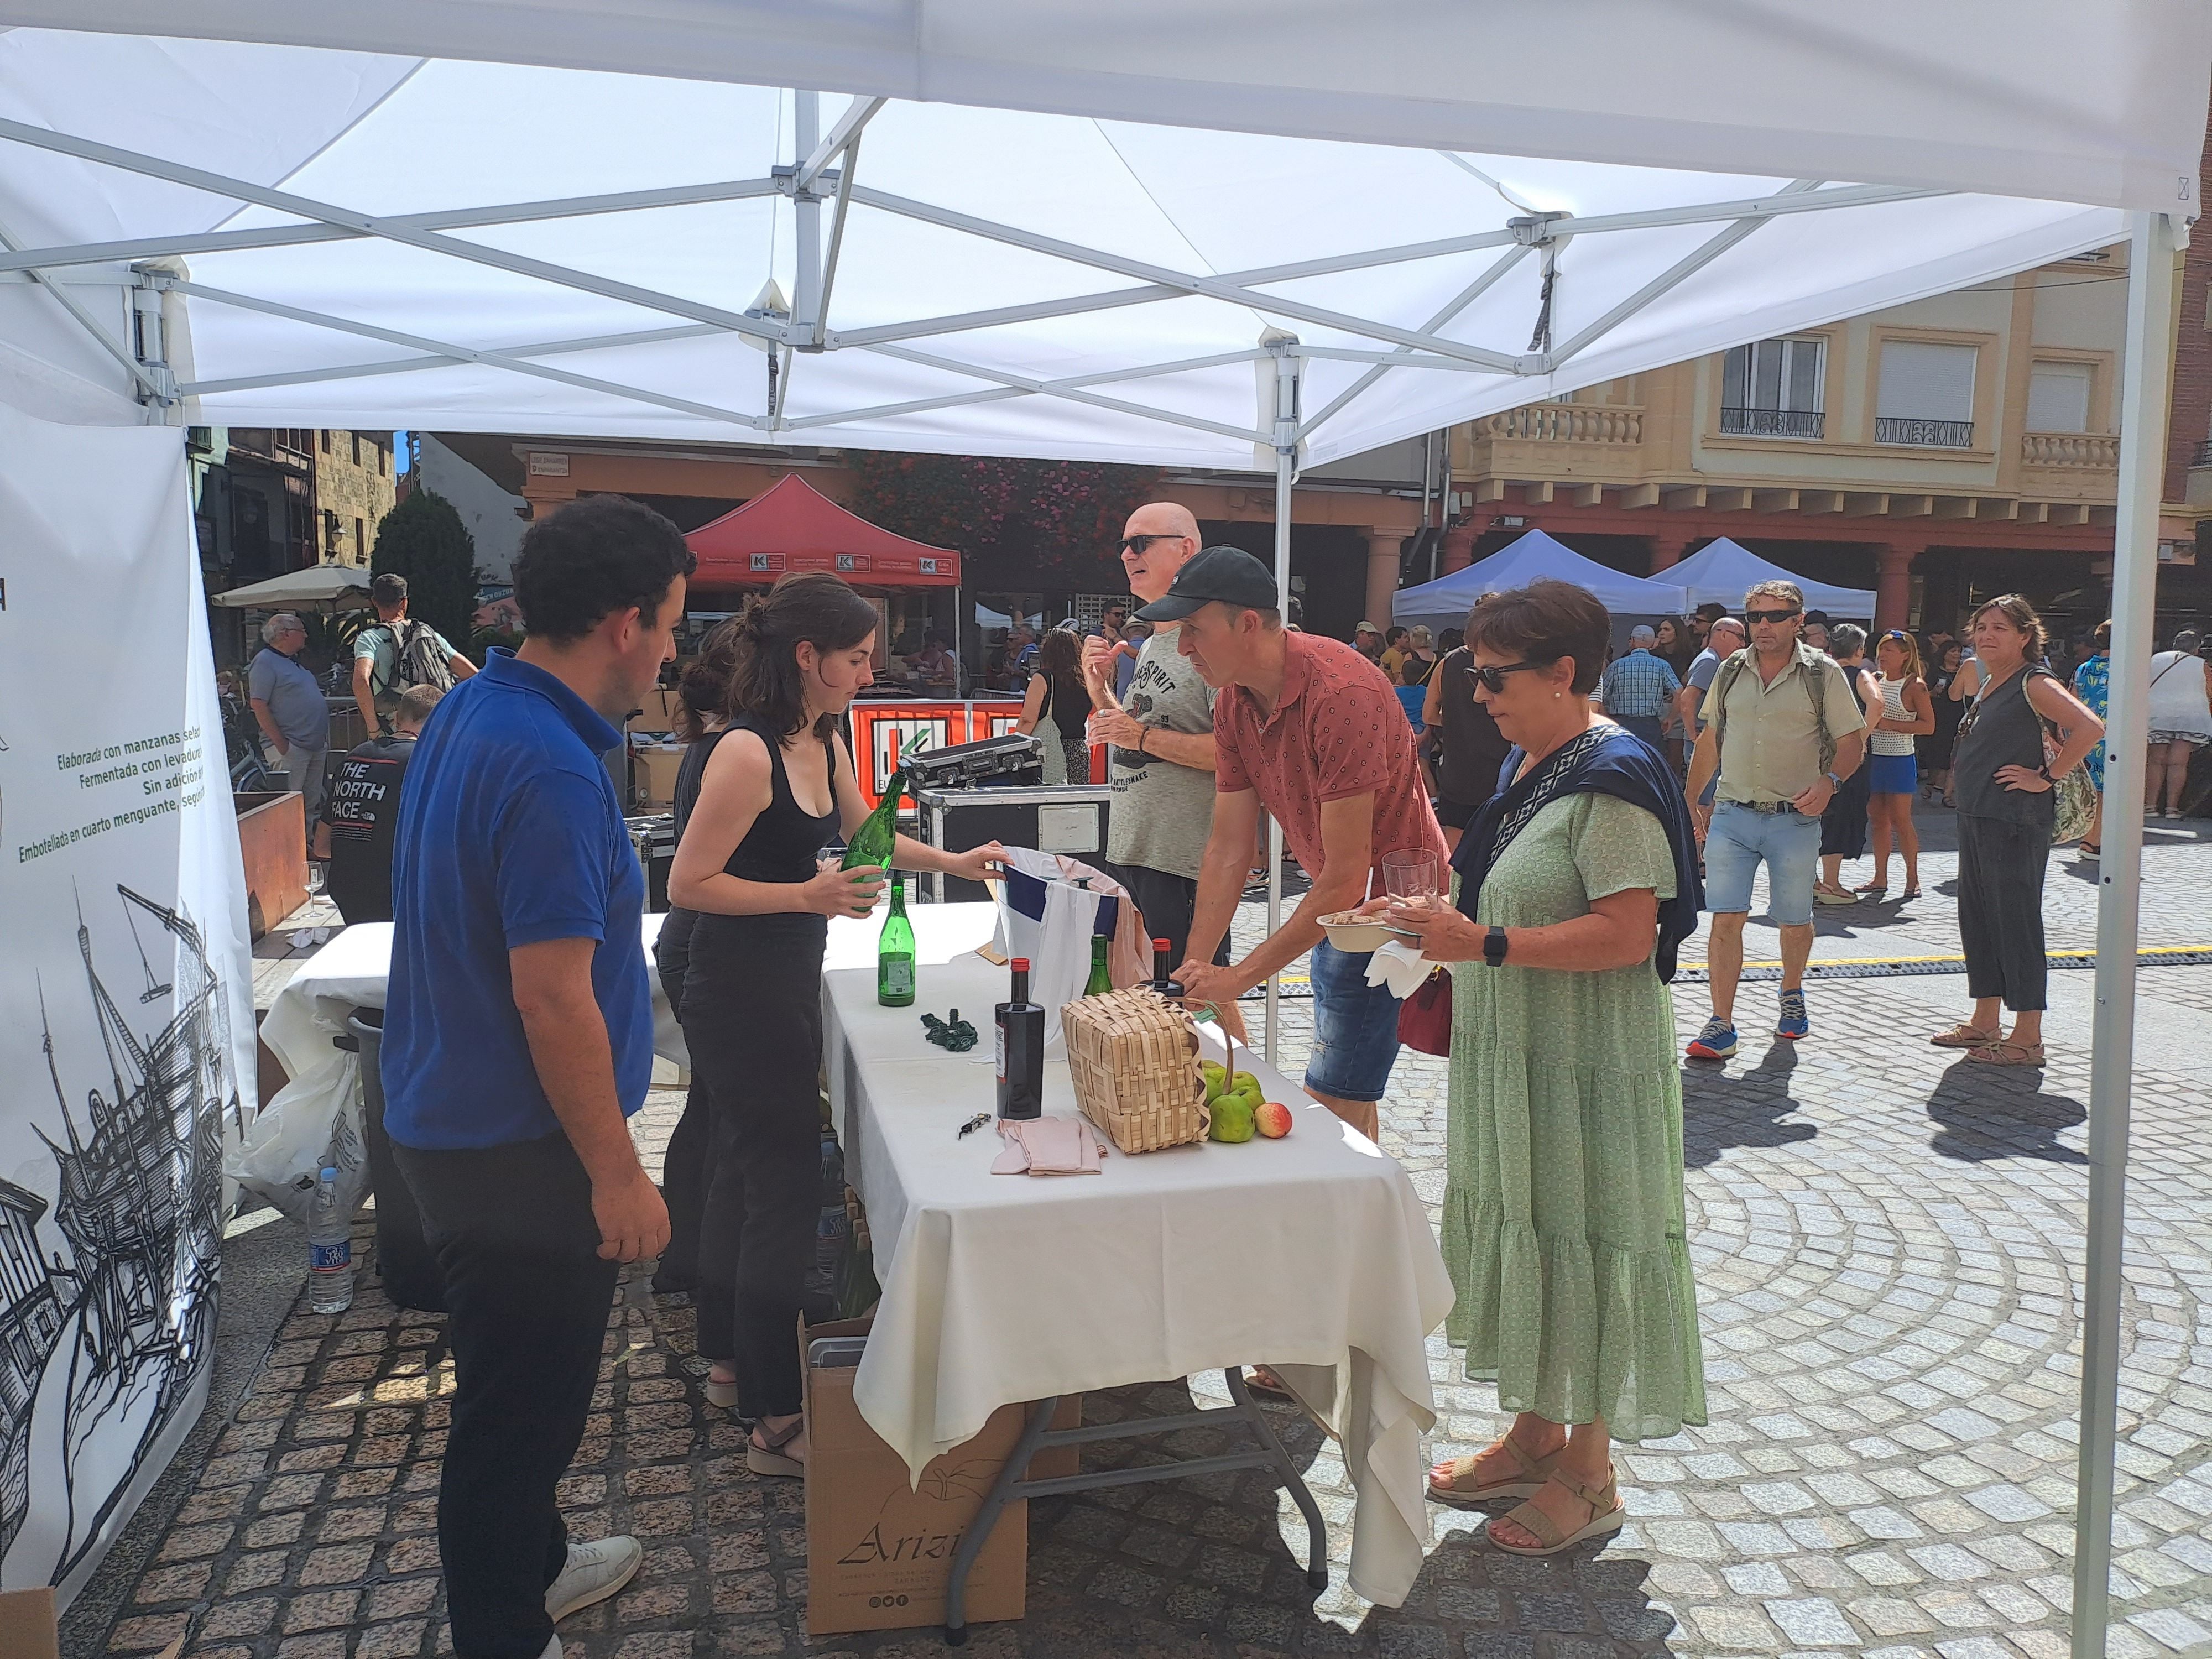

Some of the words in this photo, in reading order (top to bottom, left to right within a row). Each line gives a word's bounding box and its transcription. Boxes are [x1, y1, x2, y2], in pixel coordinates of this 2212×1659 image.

[57, 747, 101, 770] Elaborada
[103, 745, 122, 760] con
[124, 732, 181, 754] manzanas
[79, 765, 139, 789] Fermentada
[142, 760, 162, 775] con
[143, 780, 163, 796] Sin
[165, 769, 198, 791] adición
[340, 762, 371, 779] THE
[333, 780, 387, 801] NORTH
[332, 801, 361, 819] FACE
[19, 831, 69, 863] Embotellada
[70, 828, 80, 843] en
[82, 815, 111, 838] cuarto
[113, 798, 180, 827] menguante,
[837, 1521, 965, 1566] Arizi
